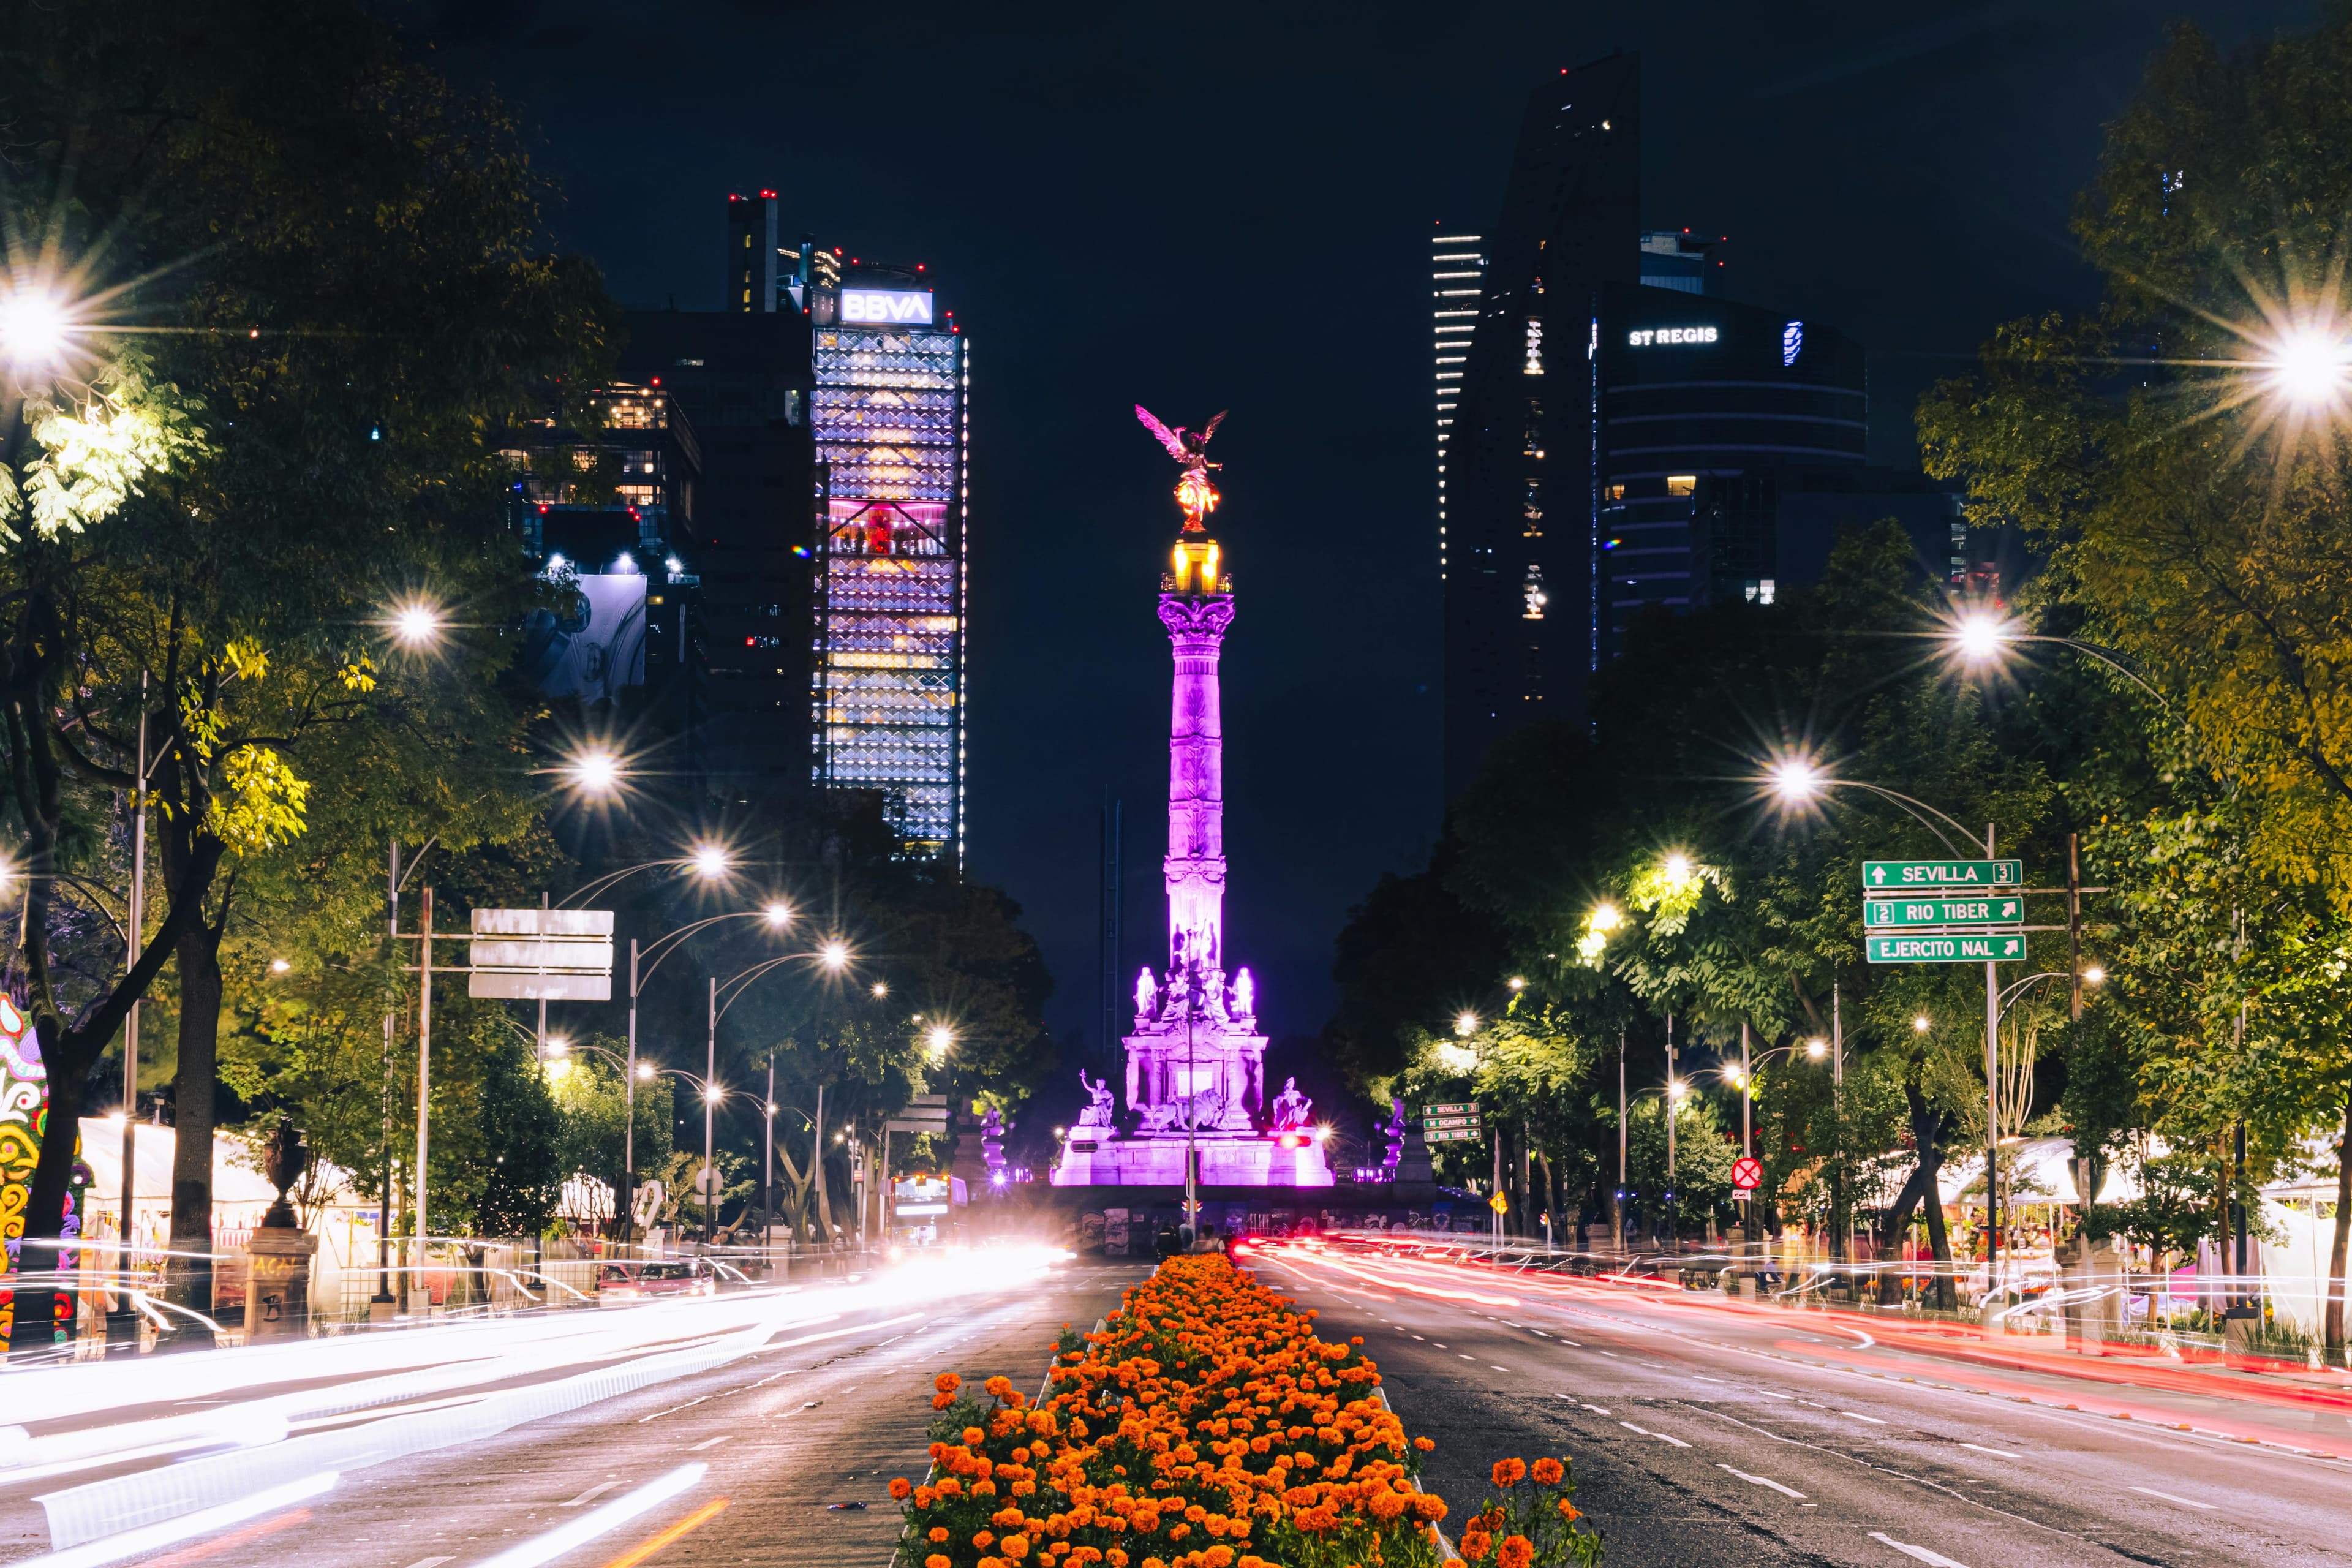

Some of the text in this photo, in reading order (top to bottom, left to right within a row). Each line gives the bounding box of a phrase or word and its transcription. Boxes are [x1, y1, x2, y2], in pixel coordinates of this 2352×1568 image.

[843, 294, 930, 321] BBVA
[1656, 327, 1717, 344] REGIS
[1902, 865, 1978, 882] SEVILLA
[1906, 904, 1935, 921] RIO
[1942, 903, 1989, 919] TIBER
[1880, 940, 1994, 957] EJERCITO NAL
